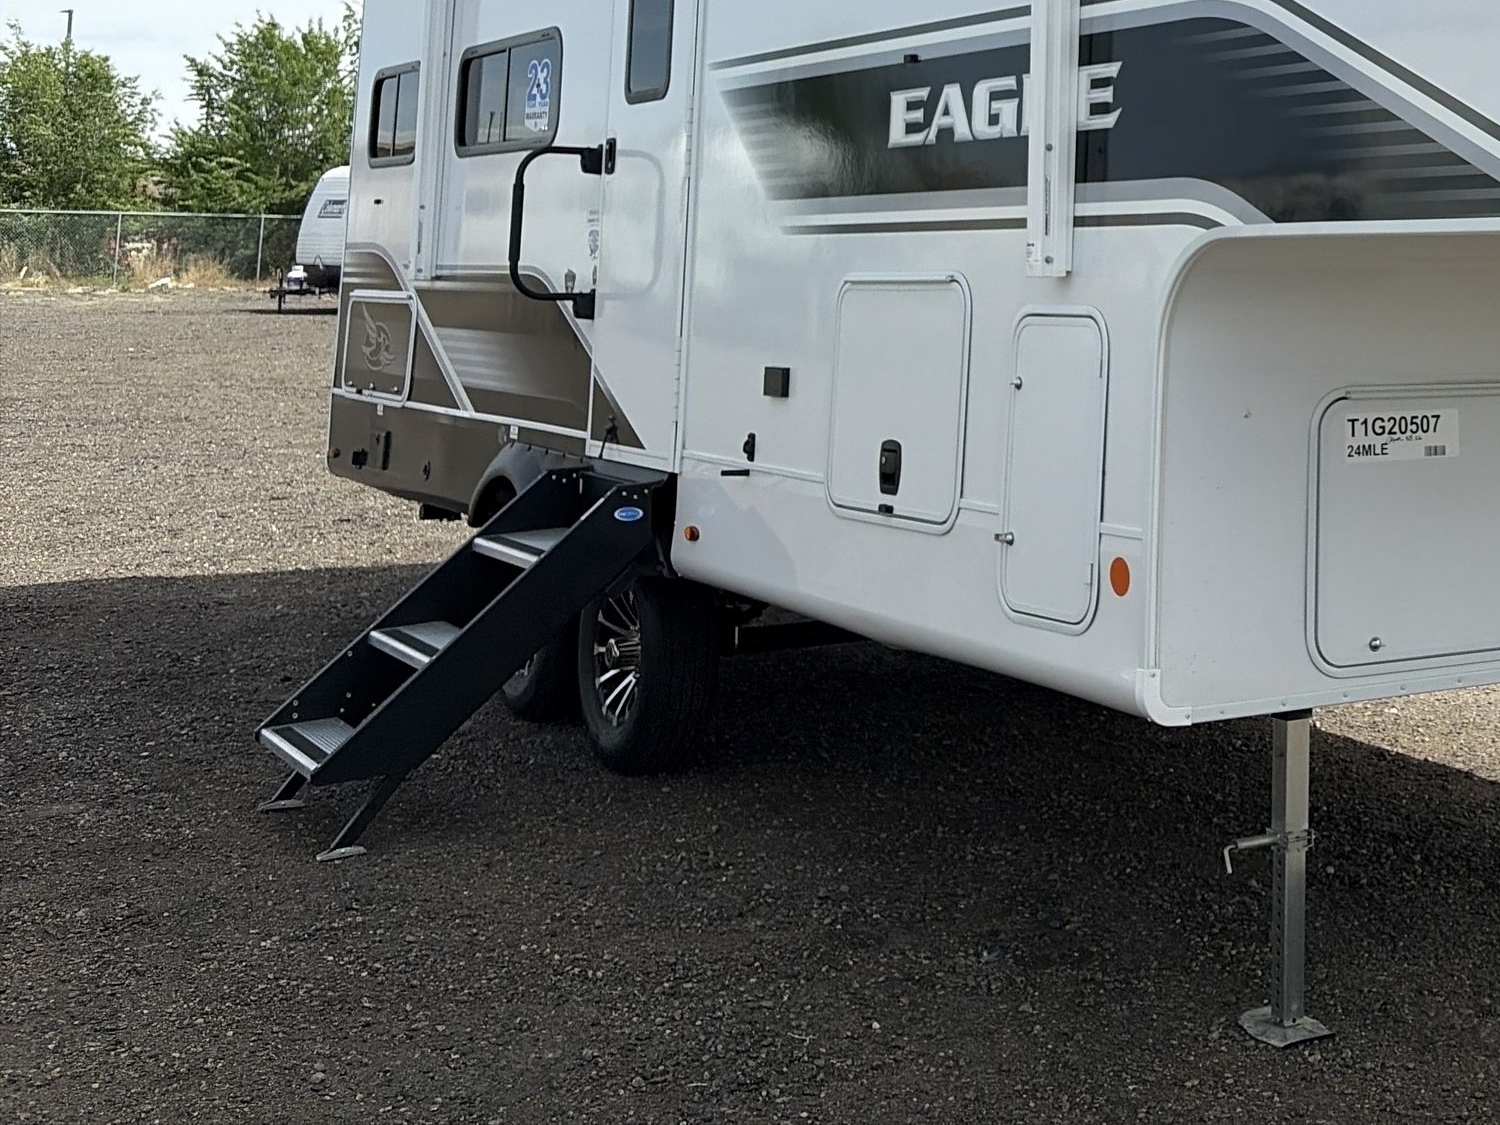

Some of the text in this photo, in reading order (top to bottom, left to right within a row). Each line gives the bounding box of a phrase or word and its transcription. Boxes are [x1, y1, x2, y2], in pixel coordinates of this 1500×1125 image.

[887, 60, 1123, 149] EAGE
[525, 111, 548, 120] WARRANTY
[1347, 414, 1441, 437] T1G20507
[1347, 442, 1389, 458] 24MLE
